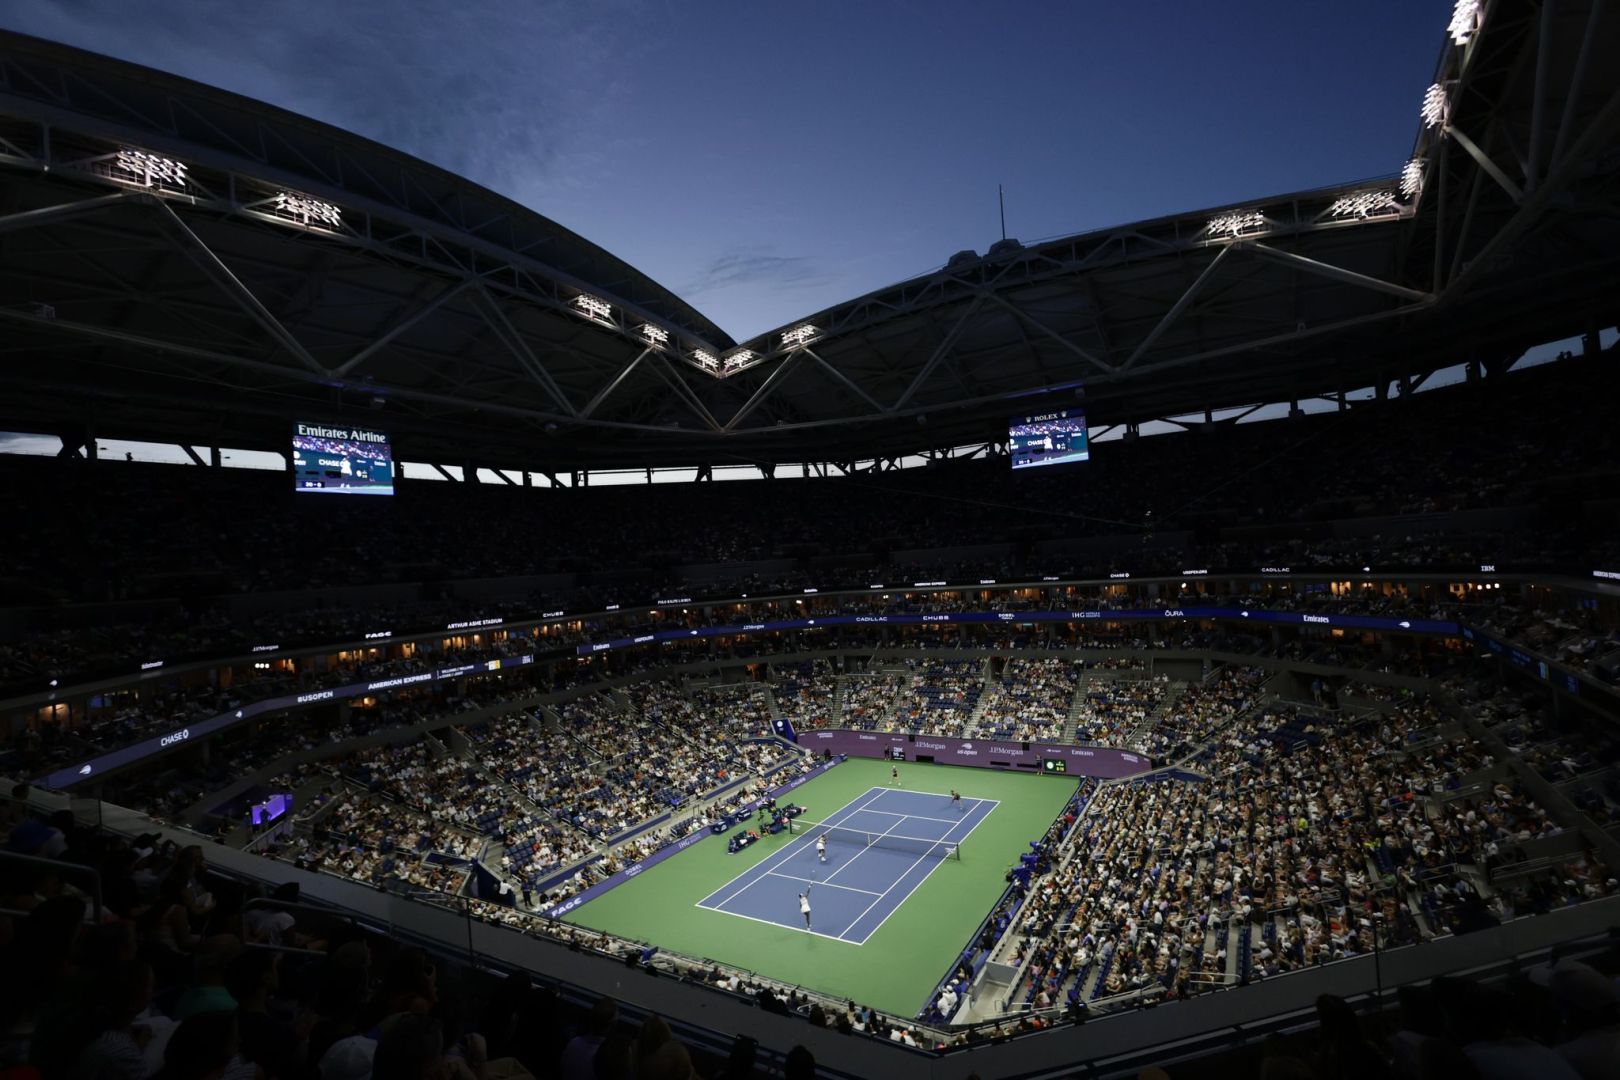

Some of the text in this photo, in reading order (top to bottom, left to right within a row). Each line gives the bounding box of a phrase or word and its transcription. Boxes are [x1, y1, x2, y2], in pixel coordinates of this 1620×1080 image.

[1034, 413, 1058, 422] ROLEX
[298, 424, 386, 443] Emirates Airline
[318, 459, 340, 467] CHASE
[1303, 614, 1330, 624] Emirates
[447, 621, 468, 629] ARTHUR
[368, 678, 403, 690] AMERICAN
[403, 673, 432, 684] EXPRESS
[161, 731, 183, 747] CHASE
[915, 741, 946, 750] J.P.Morgan
[990, 747, 1024, 756] J.P.Morgan
